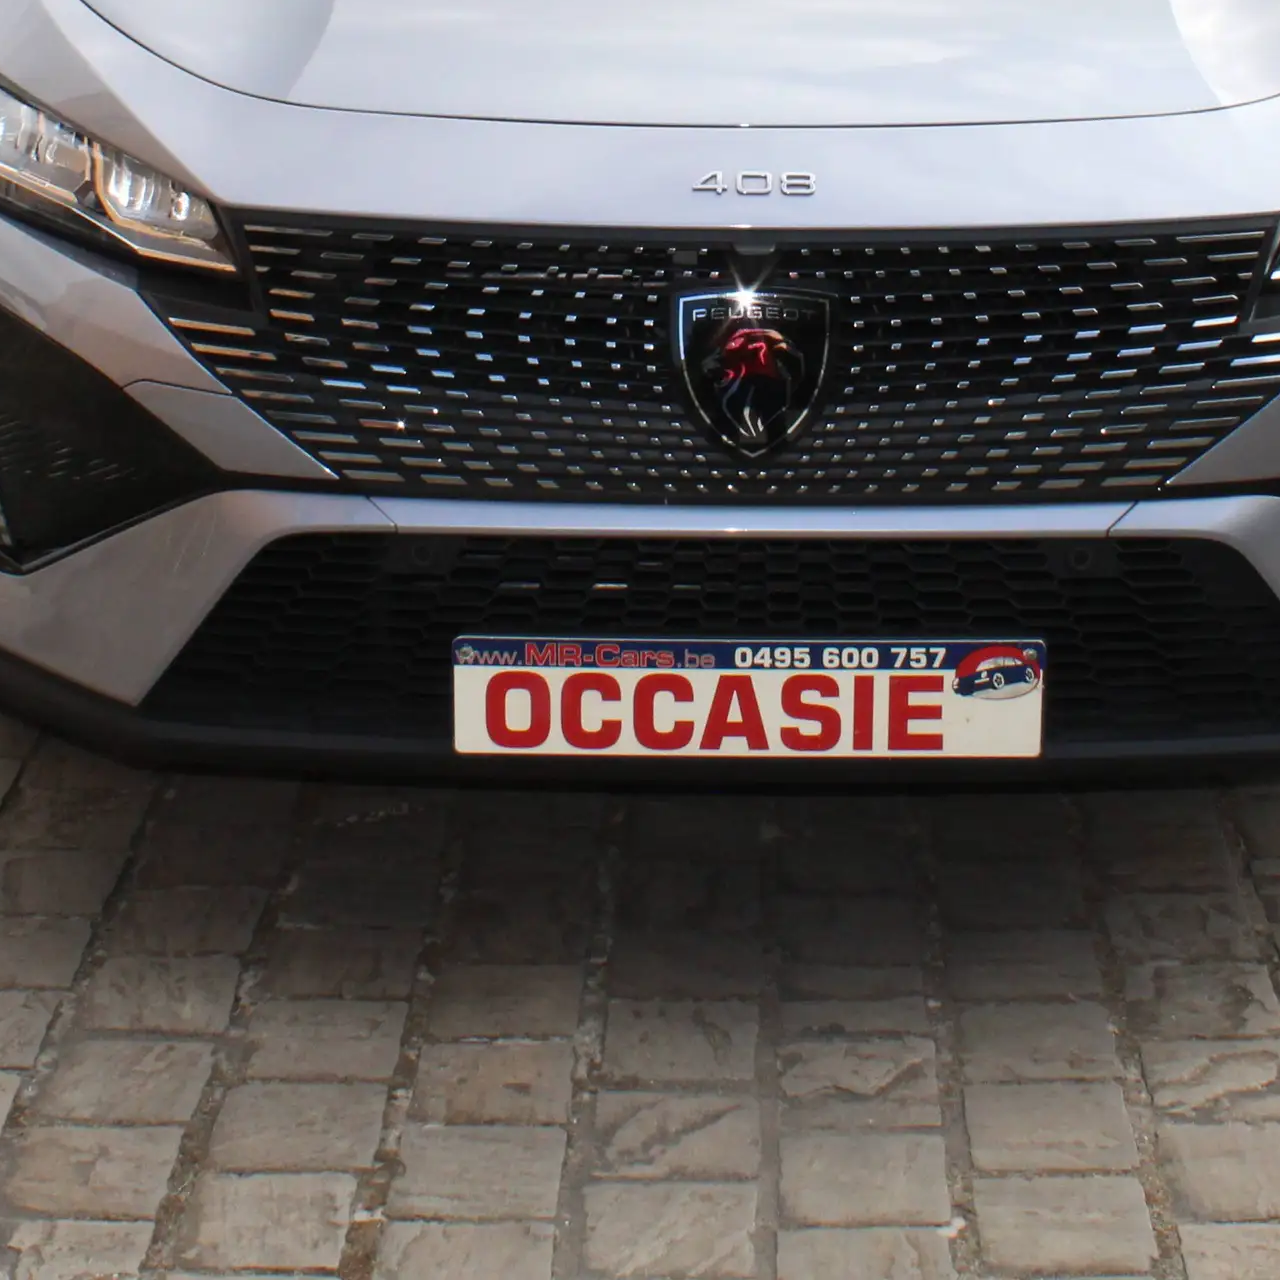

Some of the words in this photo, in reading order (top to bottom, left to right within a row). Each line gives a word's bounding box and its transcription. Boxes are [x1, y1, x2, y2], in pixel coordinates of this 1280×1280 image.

[692, 170, 816, 195] 408
[692, 306, 817, 322] PEUGEOT
[455, 642, 716, 669] www.MR-Cars.be
[734, 646, 812, 668] 0495
[822, 647, 880, 668] 600
[890, 647, 947, 669] 757
[484, 670, 945, 752] OCCASIE
